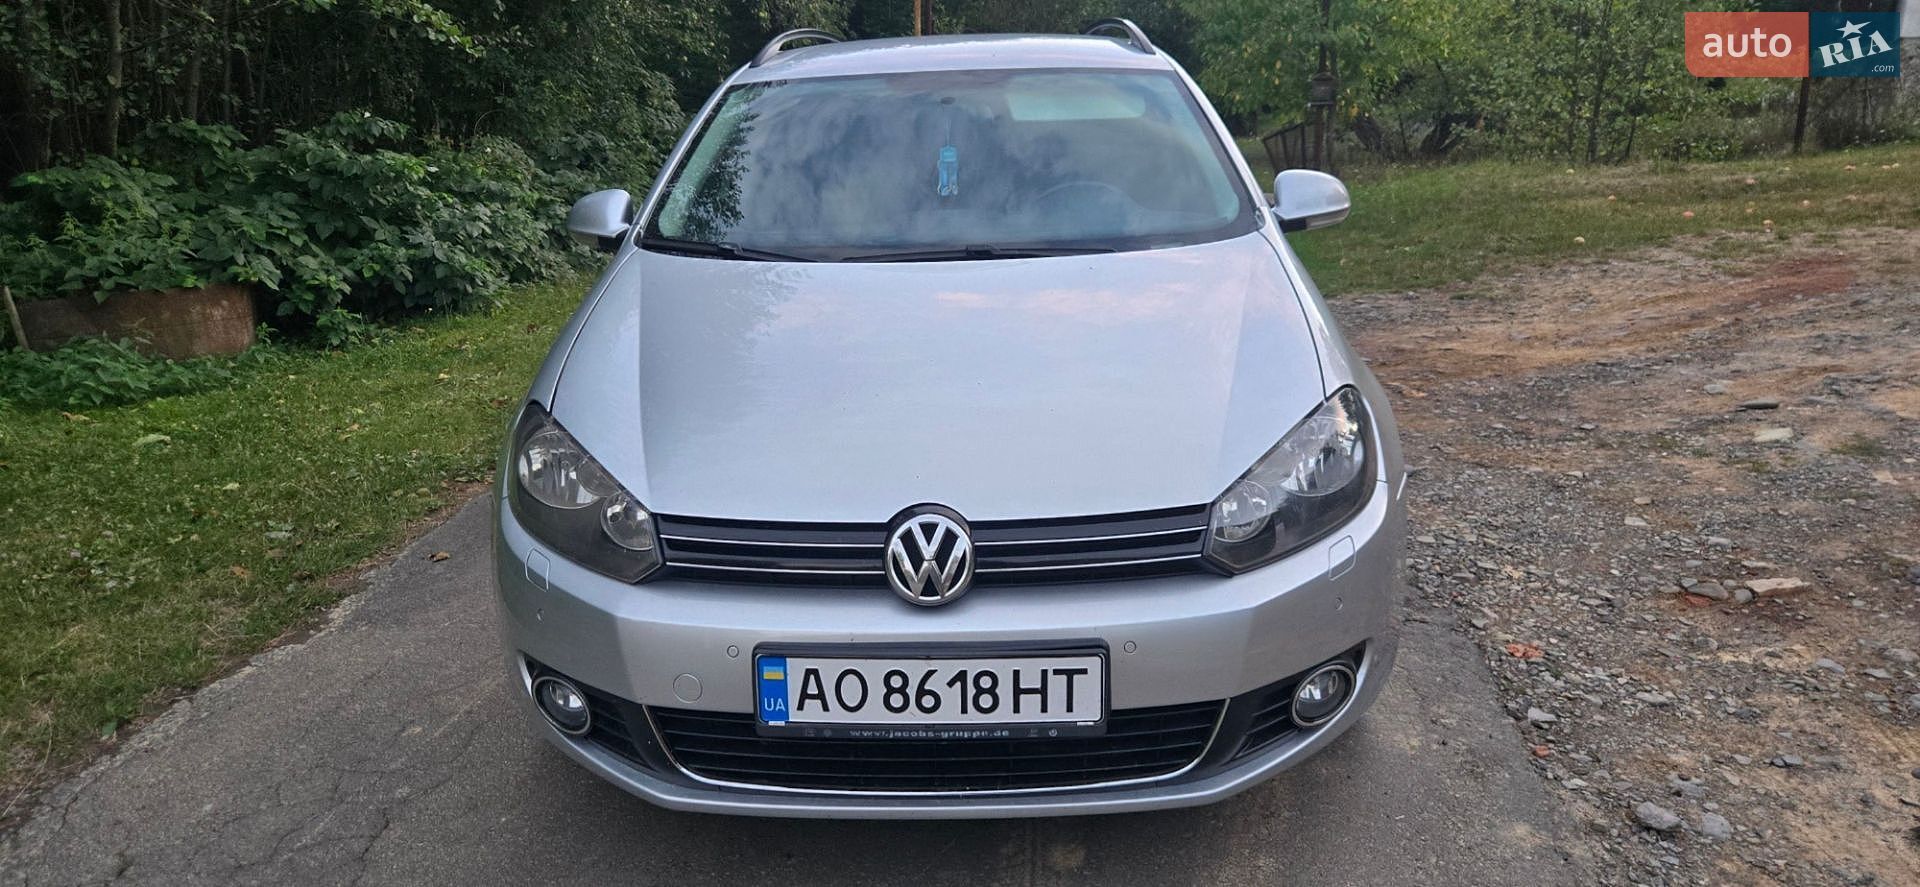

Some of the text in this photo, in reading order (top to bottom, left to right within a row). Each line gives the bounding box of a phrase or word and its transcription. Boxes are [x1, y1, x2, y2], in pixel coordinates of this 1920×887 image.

[764, 697, 786, 711] UA
[796, 668, 1088, 715] AO 8618 HT
